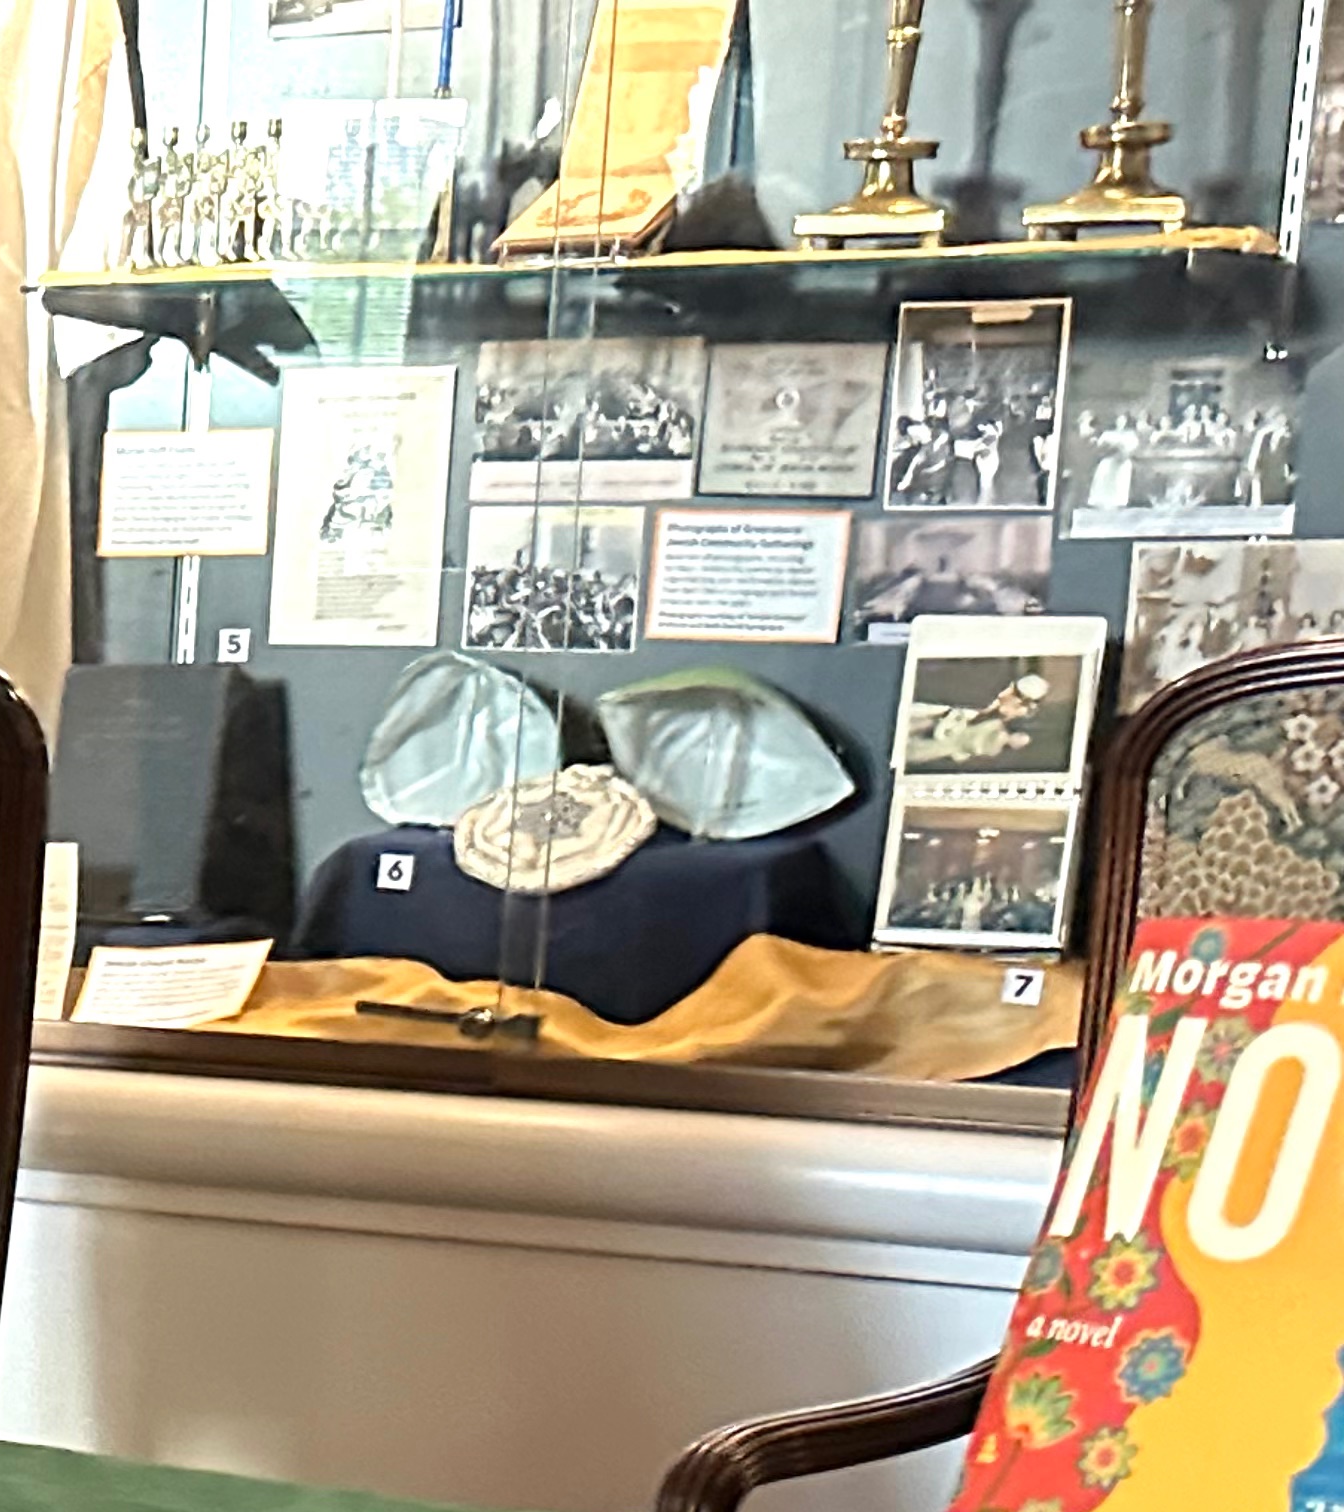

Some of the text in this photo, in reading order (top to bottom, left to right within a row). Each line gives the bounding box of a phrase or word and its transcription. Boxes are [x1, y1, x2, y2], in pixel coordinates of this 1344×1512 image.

[226, 634, 242, 655] 5
[387, 860, 404, 882] 6
[1014, 974, 1034, 998] 7
[1128, 948, 1329, 1009] Morgan
[1026, 1314, 1123, 1349] a novel
